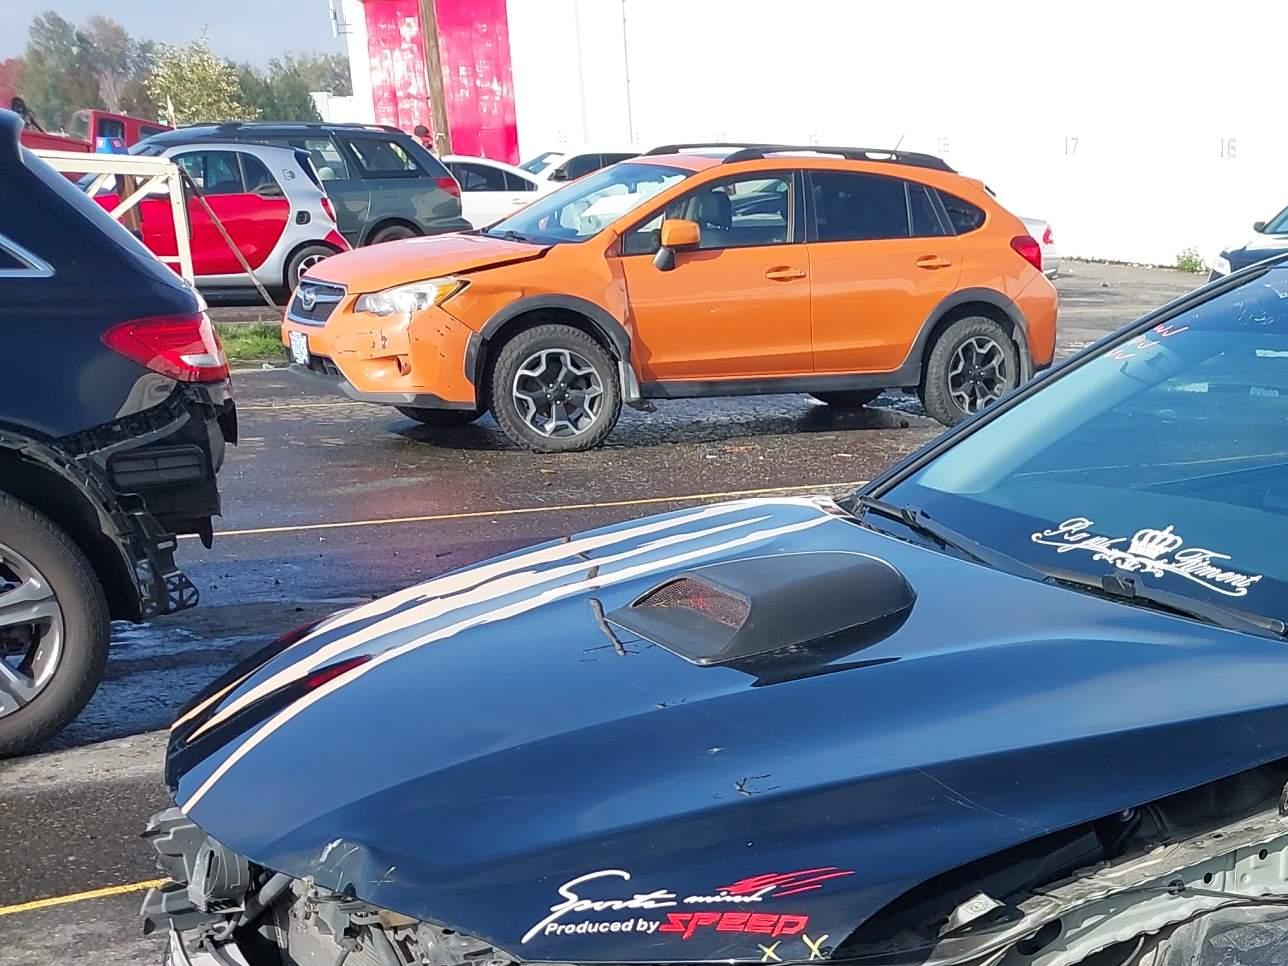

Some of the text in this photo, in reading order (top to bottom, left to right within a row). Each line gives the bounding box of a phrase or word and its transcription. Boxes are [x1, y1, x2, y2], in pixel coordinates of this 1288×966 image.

[1220, 138, 1236, 158] 16
[521, 869, 678, 944] Sports
[544, 911, 810, 940] Produced by SPEED
